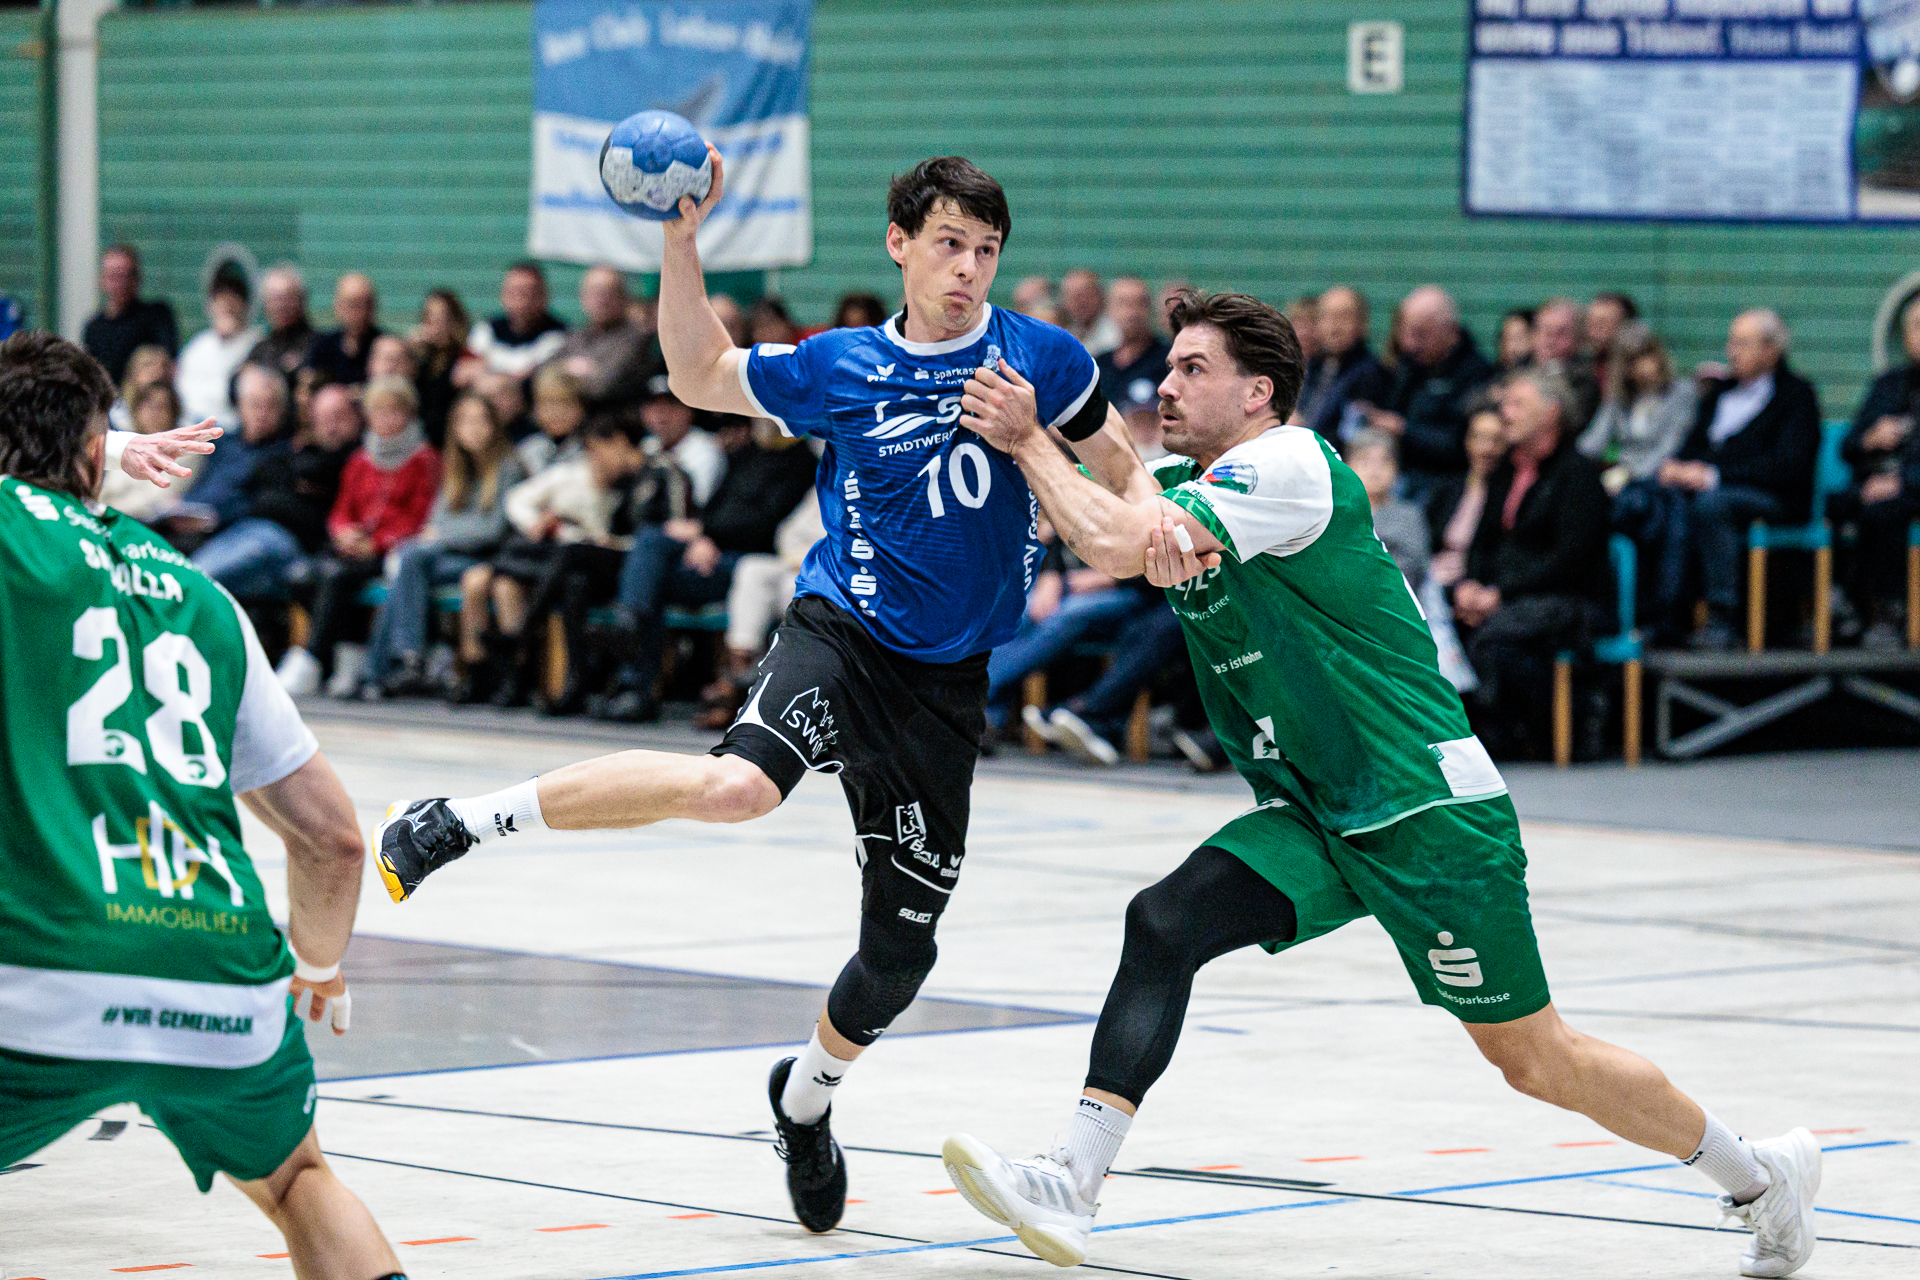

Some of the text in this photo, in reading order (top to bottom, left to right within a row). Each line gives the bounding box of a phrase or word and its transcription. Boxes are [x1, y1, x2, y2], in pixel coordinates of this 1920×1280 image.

[1362, 32, 1389, 84] E
[918, 442, 992, 518] 10
[1211, 661, 1228, 675] as
[66, 605, 227, 789] 28
[106, 902, 248, 934] IMMOBILIEN
[898, 907, 932, 924] SELECT
